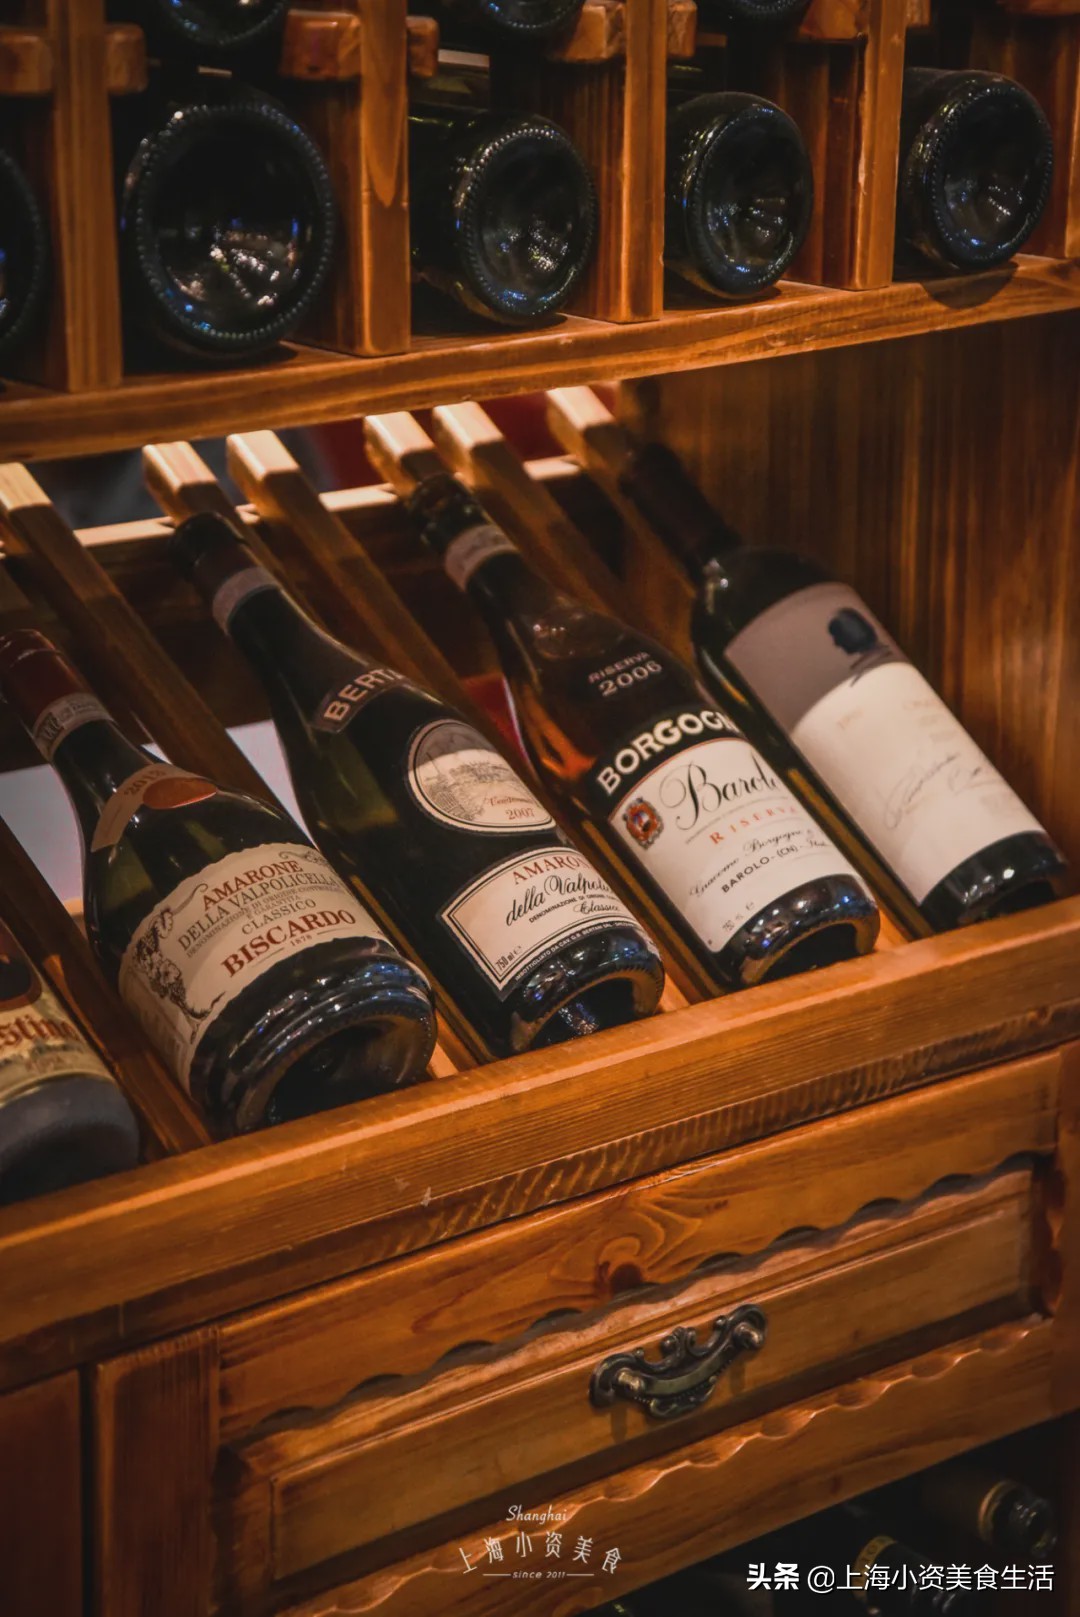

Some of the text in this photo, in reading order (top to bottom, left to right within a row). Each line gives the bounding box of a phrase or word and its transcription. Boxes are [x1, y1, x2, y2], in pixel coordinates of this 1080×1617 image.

[588, 652, 650, 683] RISERVA
[599, 660, 662, 697] 2006
[506, 807, 536, 820] 2007
[709, 805, 797, 845] RISERVA
[203, 860, 304, 911] AMARONE
[721, 844, 798, 893] BAROLO (CN)
[178, 872, 338, 951] DELLA VALPOLICELLA
[241, 898, 317, 935] CLASSICO
[506, 885, 545, 926] della
[529, 897, 577, 923] DENOMINAZIONE
[186, 907, 250, 958] DENOMINAZIONE
[221, 909, 356, 978] BISCARDO
[495, 953, 509, 971] 750
[515, 950, 551, 981] IMBOTTIGLIATO
[550, 945, 560, 953] DA
